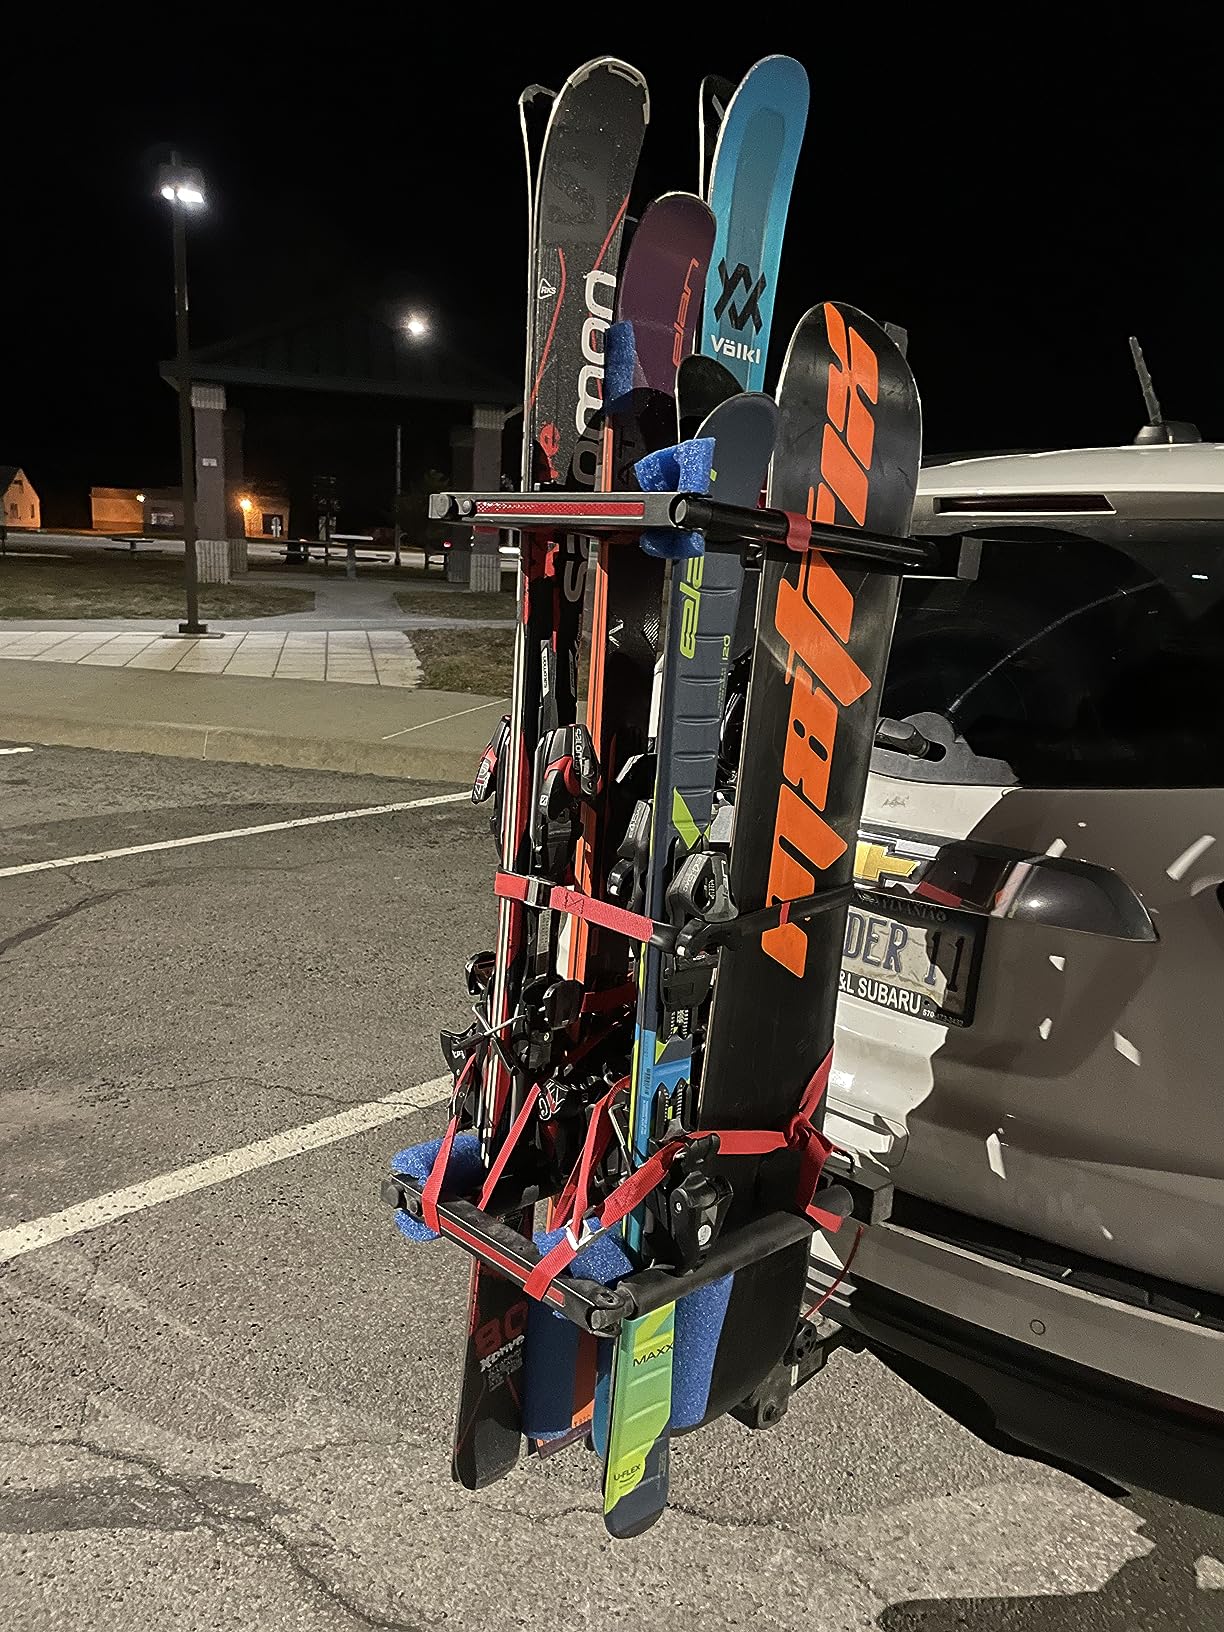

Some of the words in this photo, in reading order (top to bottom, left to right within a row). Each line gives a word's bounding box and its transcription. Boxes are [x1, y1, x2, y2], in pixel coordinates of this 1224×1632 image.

[710, 334, 761, 364] Völkl
[679, 555, 704, 660] ela
[925, 932, 966, 992] 11
[858, 977, 922, 1014] SUBARU
[633, 1341, 675, 1367] MAXX
[613, 1463, 641, 1481] U-FLEX
